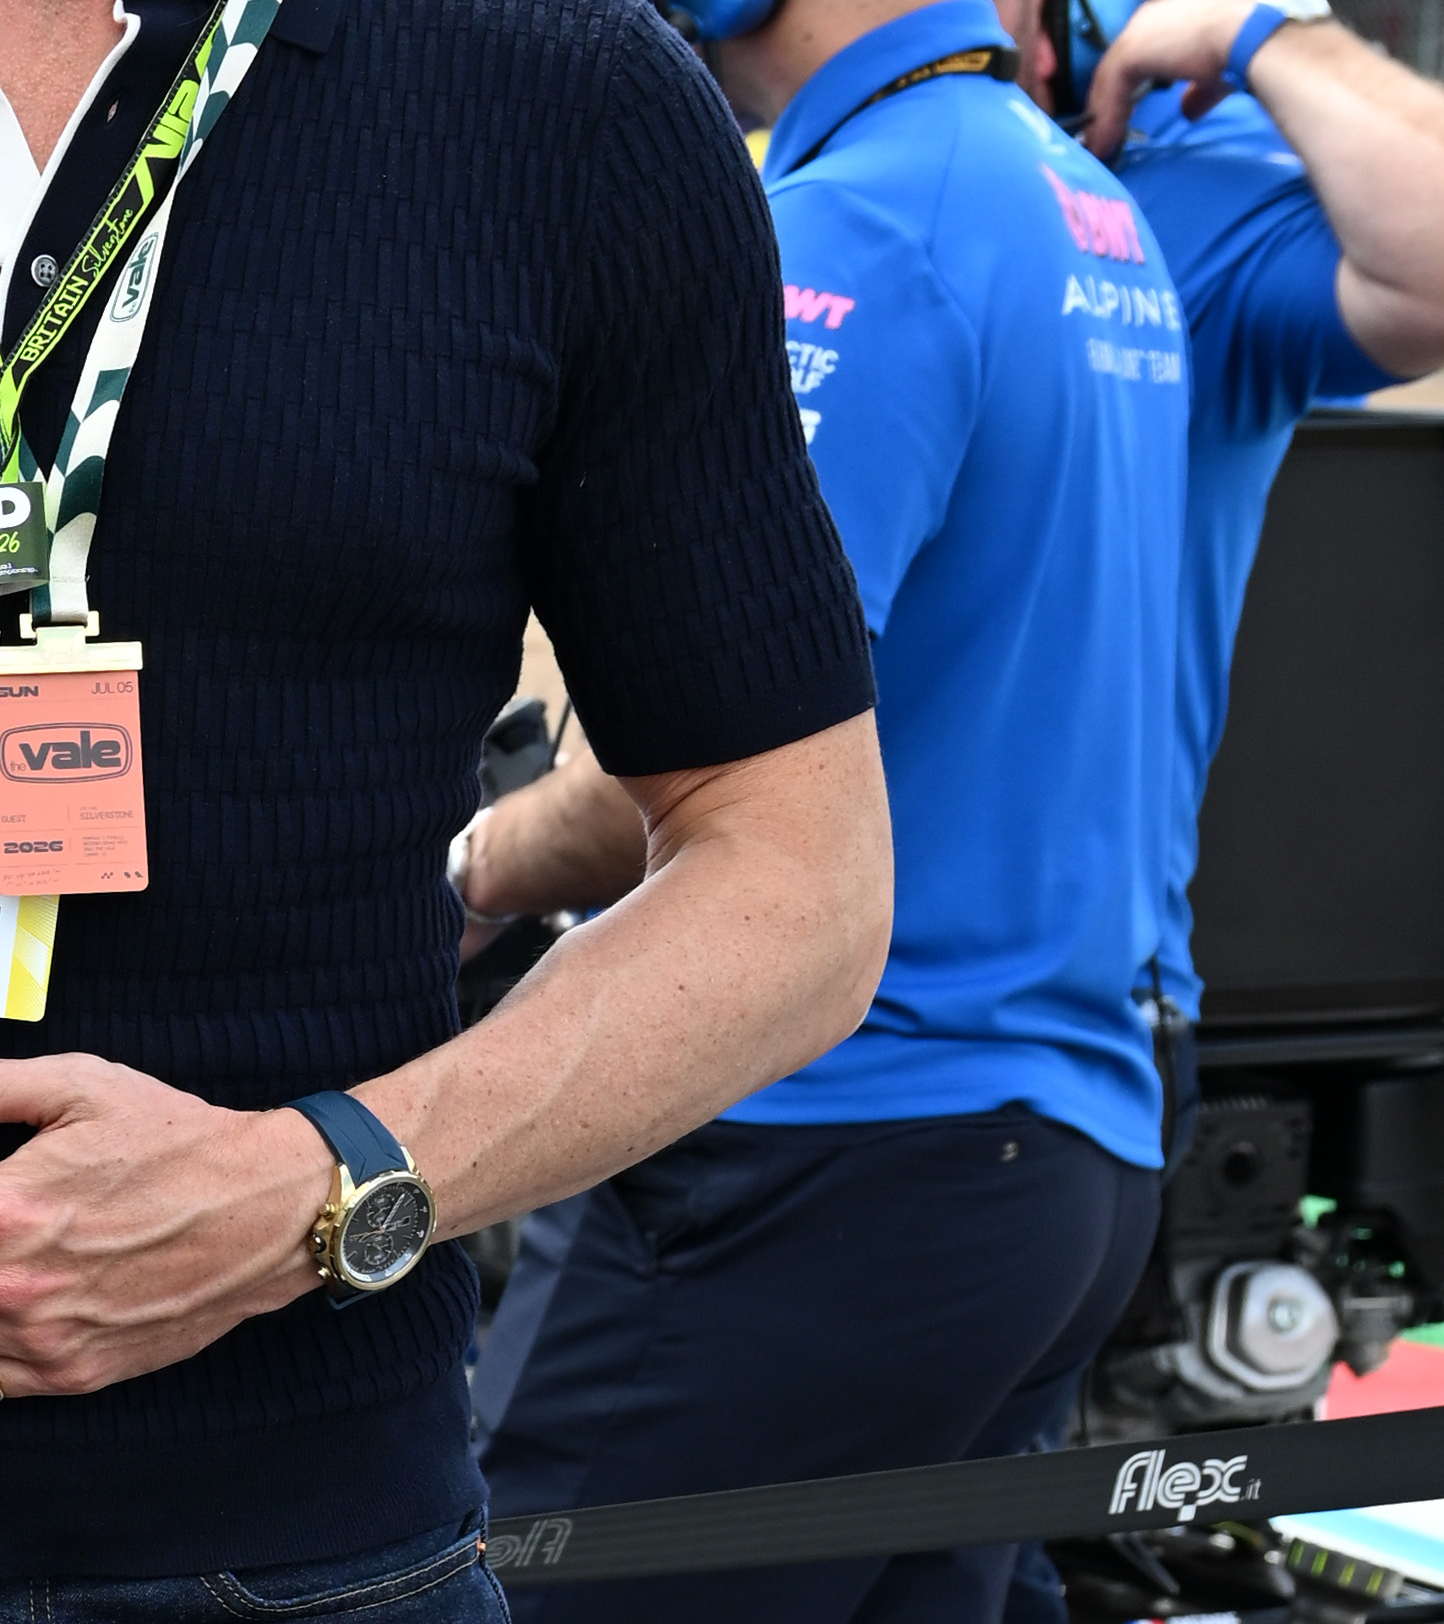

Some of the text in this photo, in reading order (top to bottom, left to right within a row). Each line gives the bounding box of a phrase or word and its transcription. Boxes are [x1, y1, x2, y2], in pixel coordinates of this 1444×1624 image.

[1061, 273, 1181, 331] ALPINE
[20, 275, 89, 363] BRITAIN
[91, 682, 115, 695] JUL
[117, 681, 134, 693] 05
[10, 730, 122, 772] the vale
[1, 814, 27, 823] GUEST
[3, 840, 63, 854] 2026
